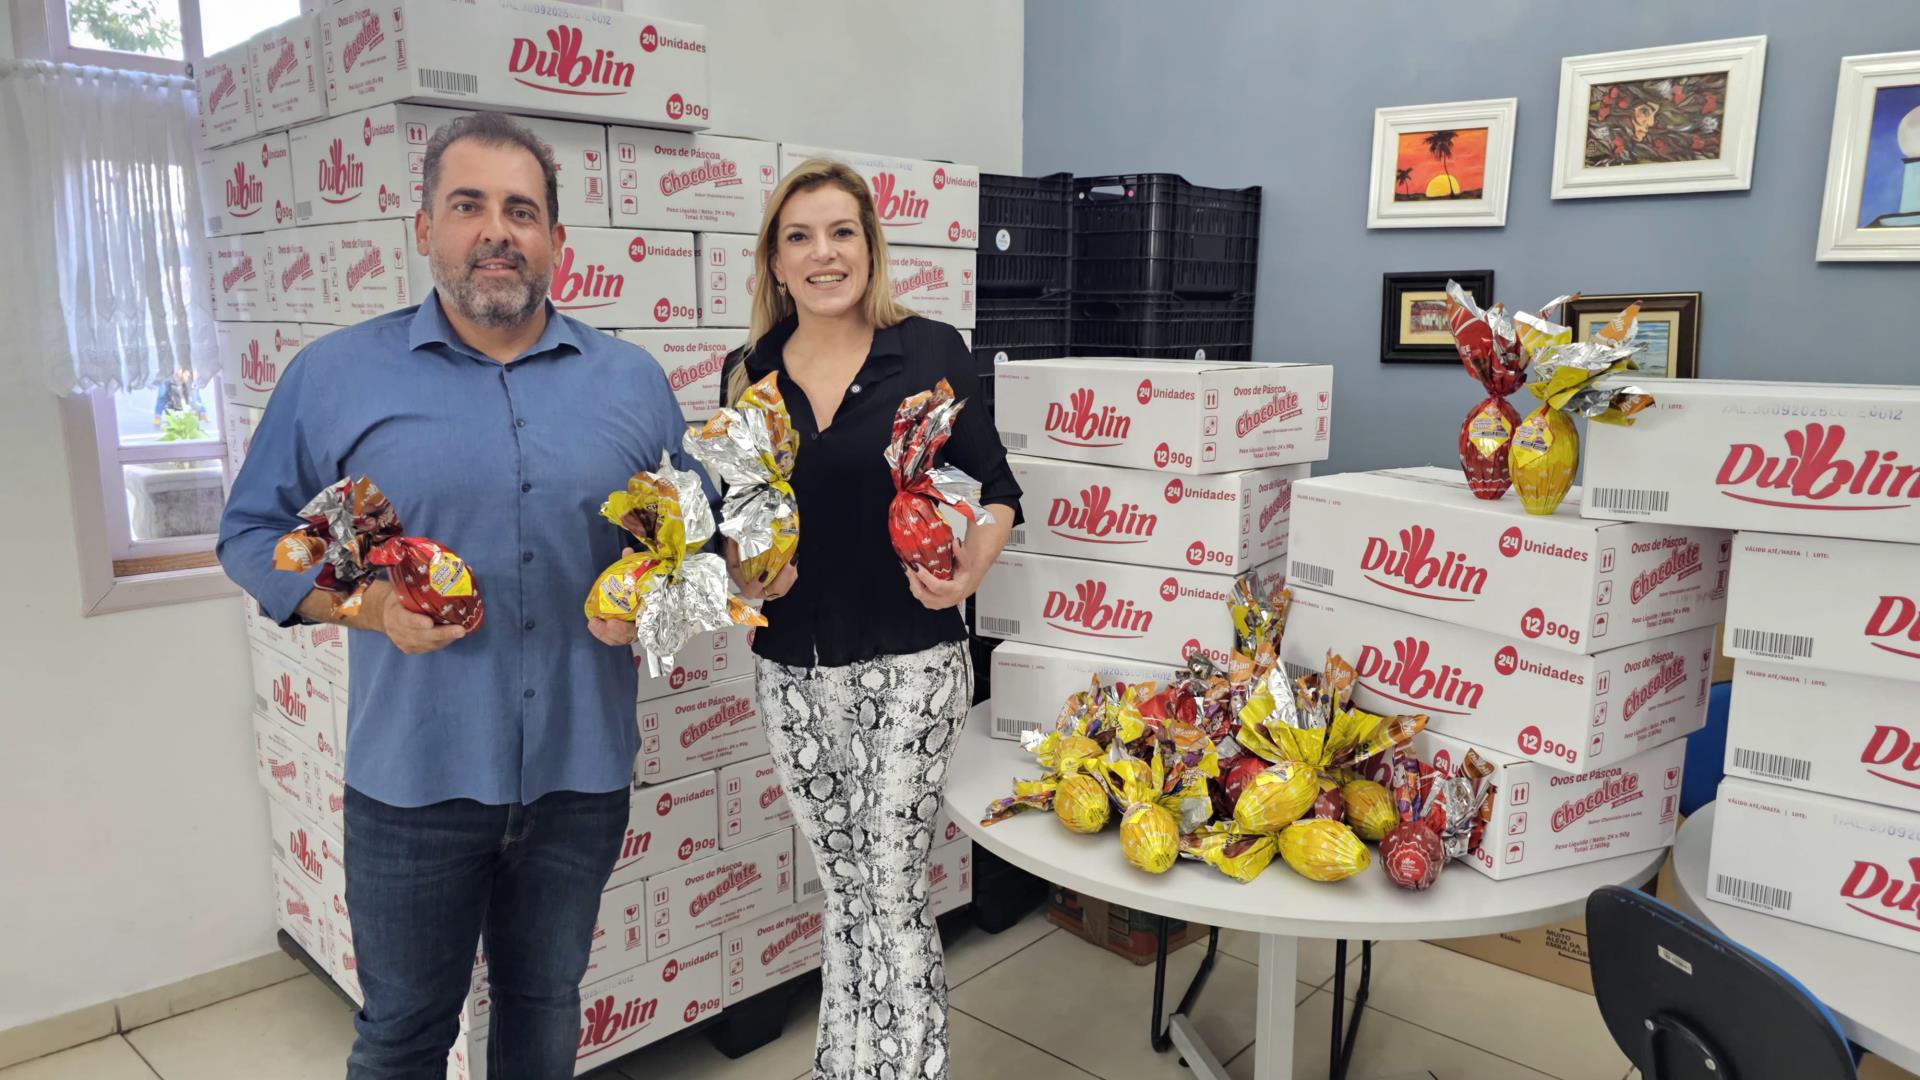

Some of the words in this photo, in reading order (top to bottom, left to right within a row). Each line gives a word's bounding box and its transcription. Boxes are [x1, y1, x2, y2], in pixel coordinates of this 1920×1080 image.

[343, 13, 381, 74] Chocolate
[509, 25, 635, 87] Dublin
[659, 36, 706, 53] Unidades
[685, 103, 709, 120] 90g
[655, 145, 677, 157] Ovos
[678, 147, 689, 157] de
[691, 148, 720, 160] Páscoa
[319, 138, 364, 196] Dublin
[659, 159, 738, 197] Chocolate
[226, 161, 263, 210] Dublin
[946, 176, 978, 188] Unidades
[872, 172, 929, 221] blin
[960, 228, 977, 241] 90g
[648, 246, 692, 257] Unidades
[550, 248, 624, 303] blin
[672, 306, 694, 320] 90g
[664, 343, 684, 353] Ovos
[686, 343, 696, 352] de
[698, 342, 727, 352] Páscoa
[241, 339, 276, 385] Dublin
[669, 353, 725, 391] Chocola
[1153, 388, 1196, 400] Unidades
[1234, 386, 1251, 396] Ovos
[1253, 385, 1261, 395] de
[1263, 384, 1287, 394] Páscoa
[1045, 388, 1131, 440] Dublin
[1236, 391, 1299, 439] Chocolate
[1171, 450, 1192, 468] 90g
[1716, 422, 1920, 500] Dublin
[1184, 488, 1237, 502] Unidades
[1048, 485, 1157, 537] Dublin
[1501, 535, 1519, 549] 24
[1523, 539, 1588, 562] Unidades
[1631, 542, 1650, 554] Ovos
[1652, 539, 1660, 550] de
[1662, 536, 1687, 549] Páscoa
[1206, 551, 1234, 566] 90g
[1360, 524, 1488, 595] Dublin
[1630, 543, 1700, 605] Chocolate
[1043, 579, 1152, 632] Dublin
[1546, 620, 1580, 645] 90g
[1203, 648, 1229, 665] 90g
[1497, 653, 1515, 668] 24
[1520, 659, 1584, 685] Unidades
[1624, 661, 1641, 674] Ovos
[1642, 657, 1650, 668] de
[687, 670, 708, 682] 90g
[1356, 636, 1484, 709] Dublin
[273, 672, 306, 722] Dublin
[1623, 656, 1685, 721] Chocolate
[675, 704, 696, 715] Ovos
[697, 700, 707, 711] de
[708, 694, 736, 707] Páscoa
[680, 698, 750, 749] Chocolate
[1543, 740, 1578, 764] 90g
[756, 767, 774, 778] Ovos
[1551, 774, 1574, 787] Ovos
[1589, 768, 1622, 782] Páscoa
[673, 788, 715, 806] Unidades
[1551, 773, 1639, 832] Chocolate
[290, 828, 323, 880] Dublin
[695, 839, 716, 851] 90g
[685, 874, 705, 886] Ovos
[706, 870, 716, 881] de
[716, 861, 743, 876] Páscoa
[688, 862, 757, 918] Chocolate
[757, 925, 775, 937] Ovos
[775, 920, 785, 930] de
[761, 912, 822, 966] Chocolate
[1546, 929, 1571, 941] MUITO
[679, 950, 719, 972] Unidades
[1545, 941, 1587, 957] EMBALAGE
[700, 998, 721, 1013] 90g
[577, 995, 658, 1050] ublin
